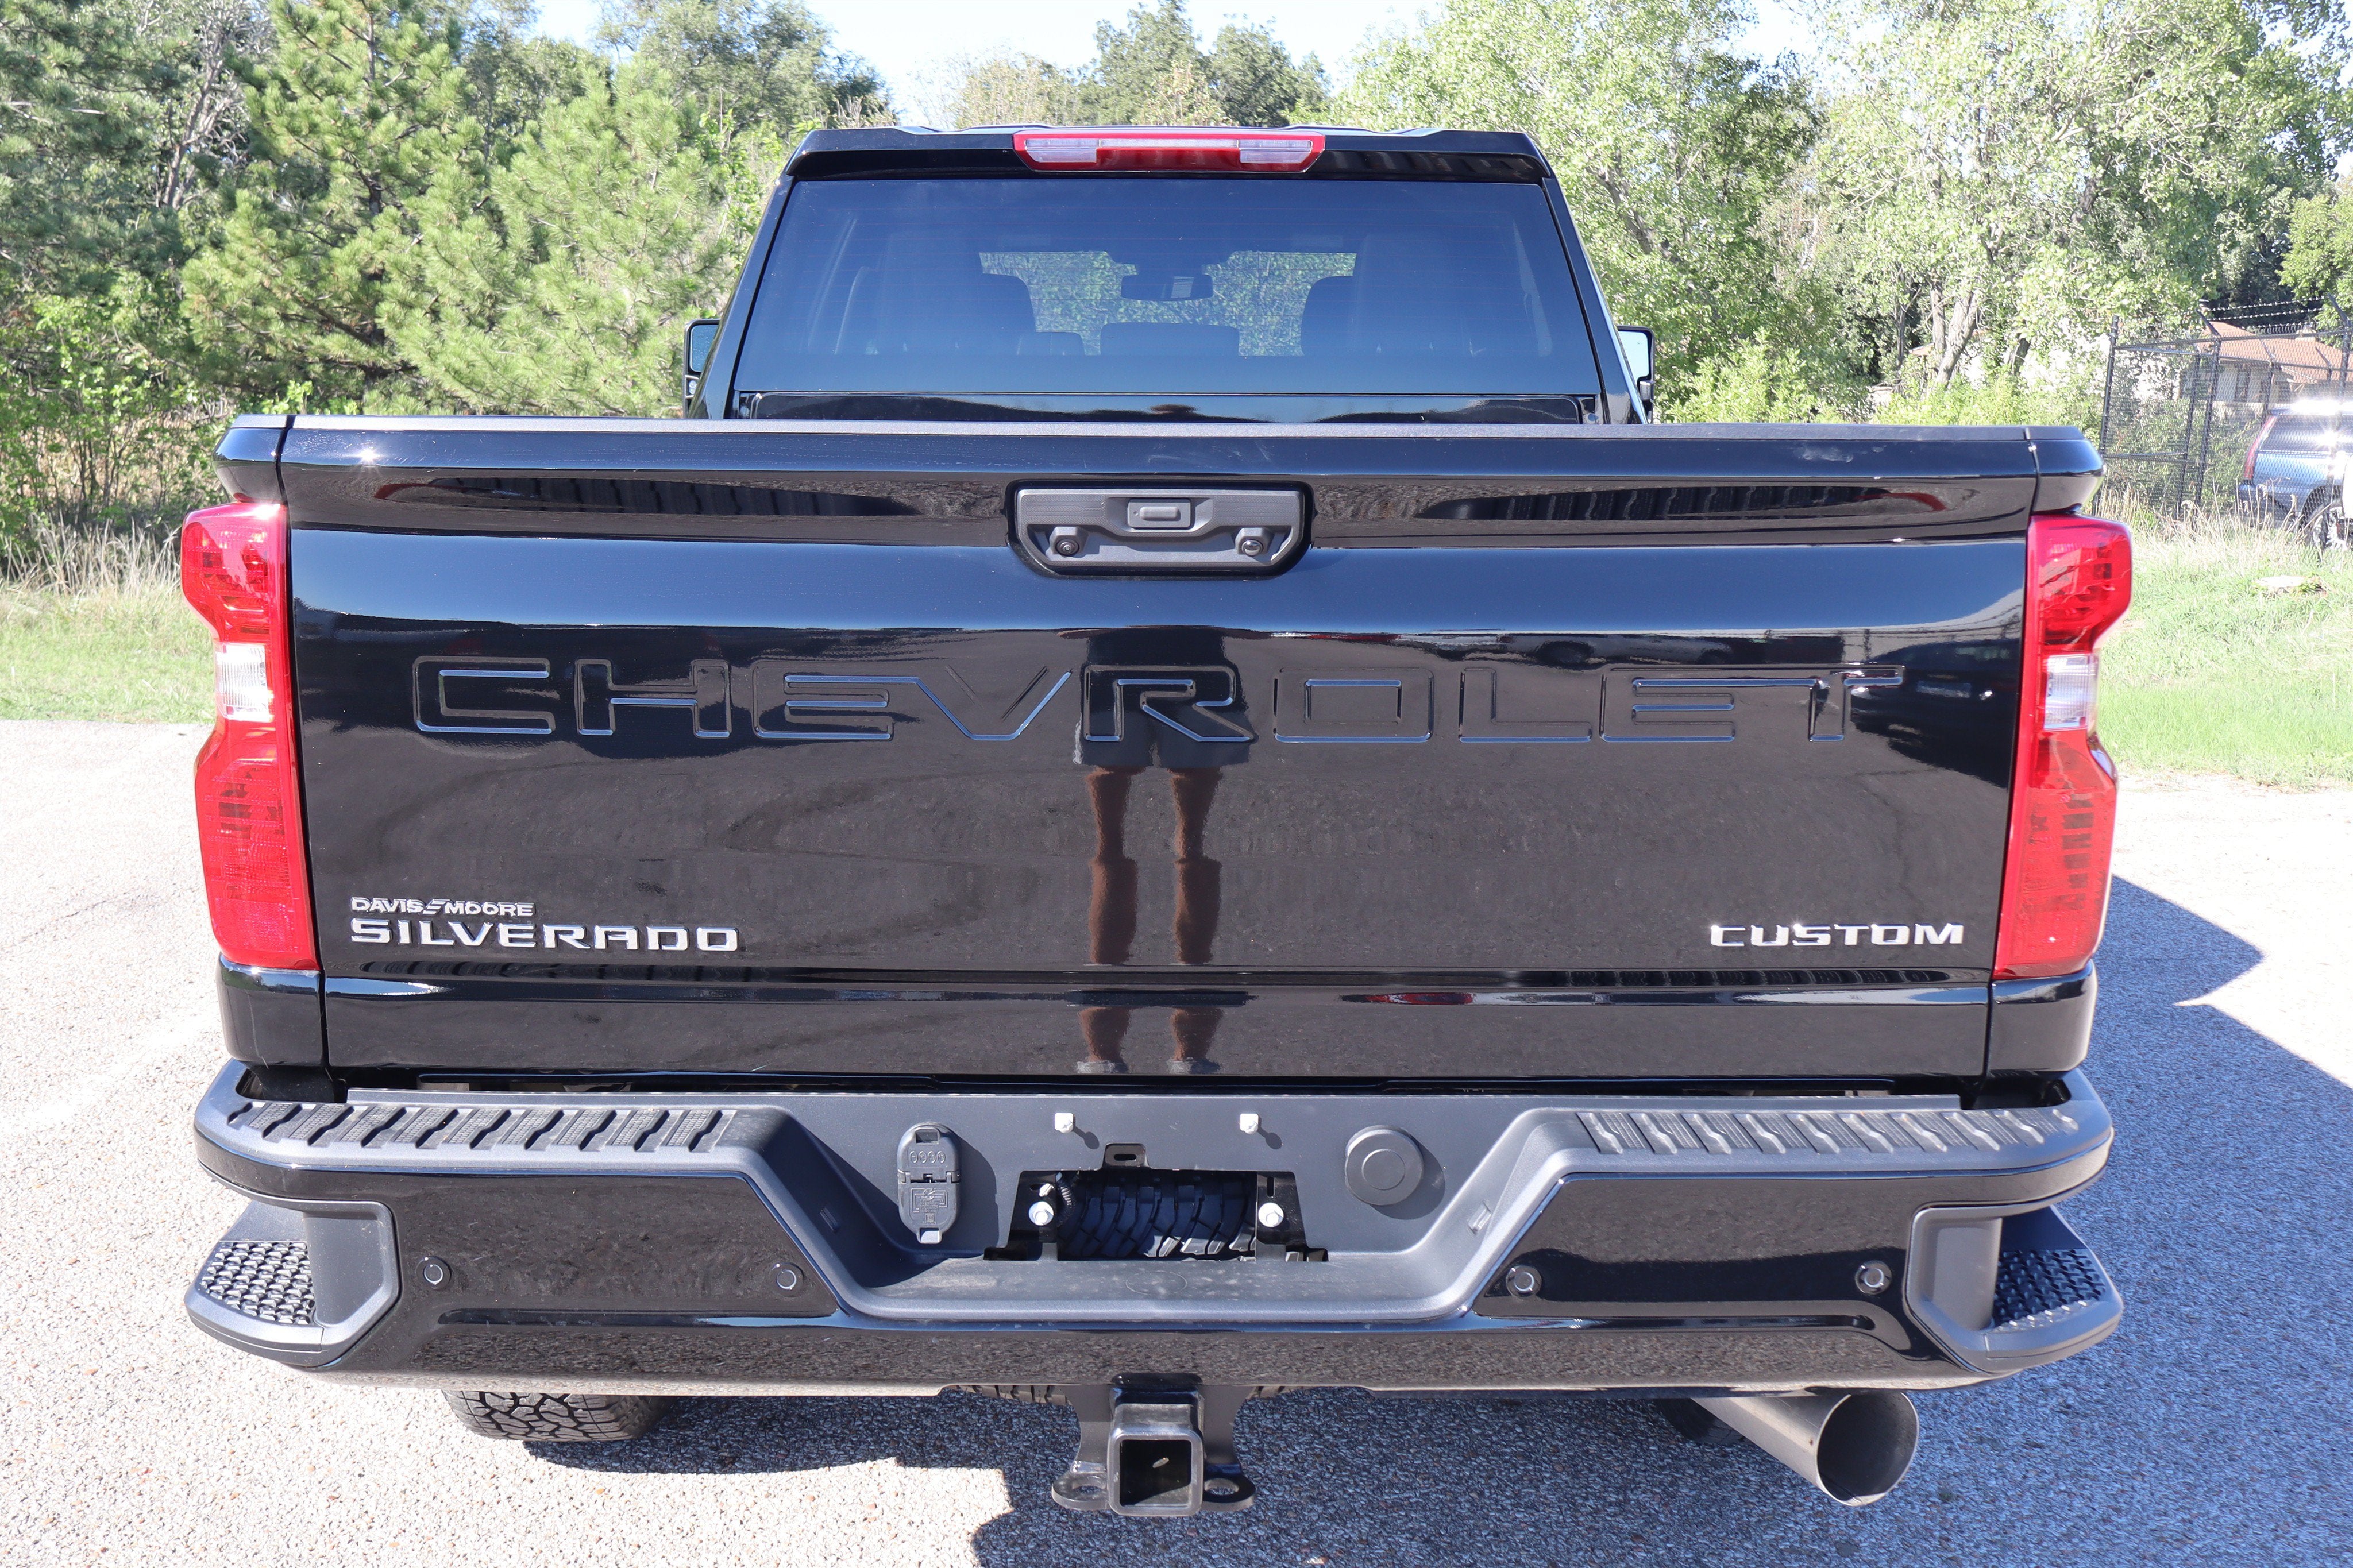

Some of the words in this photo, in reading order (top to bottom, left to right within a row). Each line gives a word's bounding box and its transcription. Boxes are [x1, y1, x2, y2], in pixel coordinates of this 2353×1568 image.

[411, 655, 1905, 743] CHEVROLET
[350, 918, 739, 952] SILVERADO
[1710, 923, 1965, 947] CUSTOM
